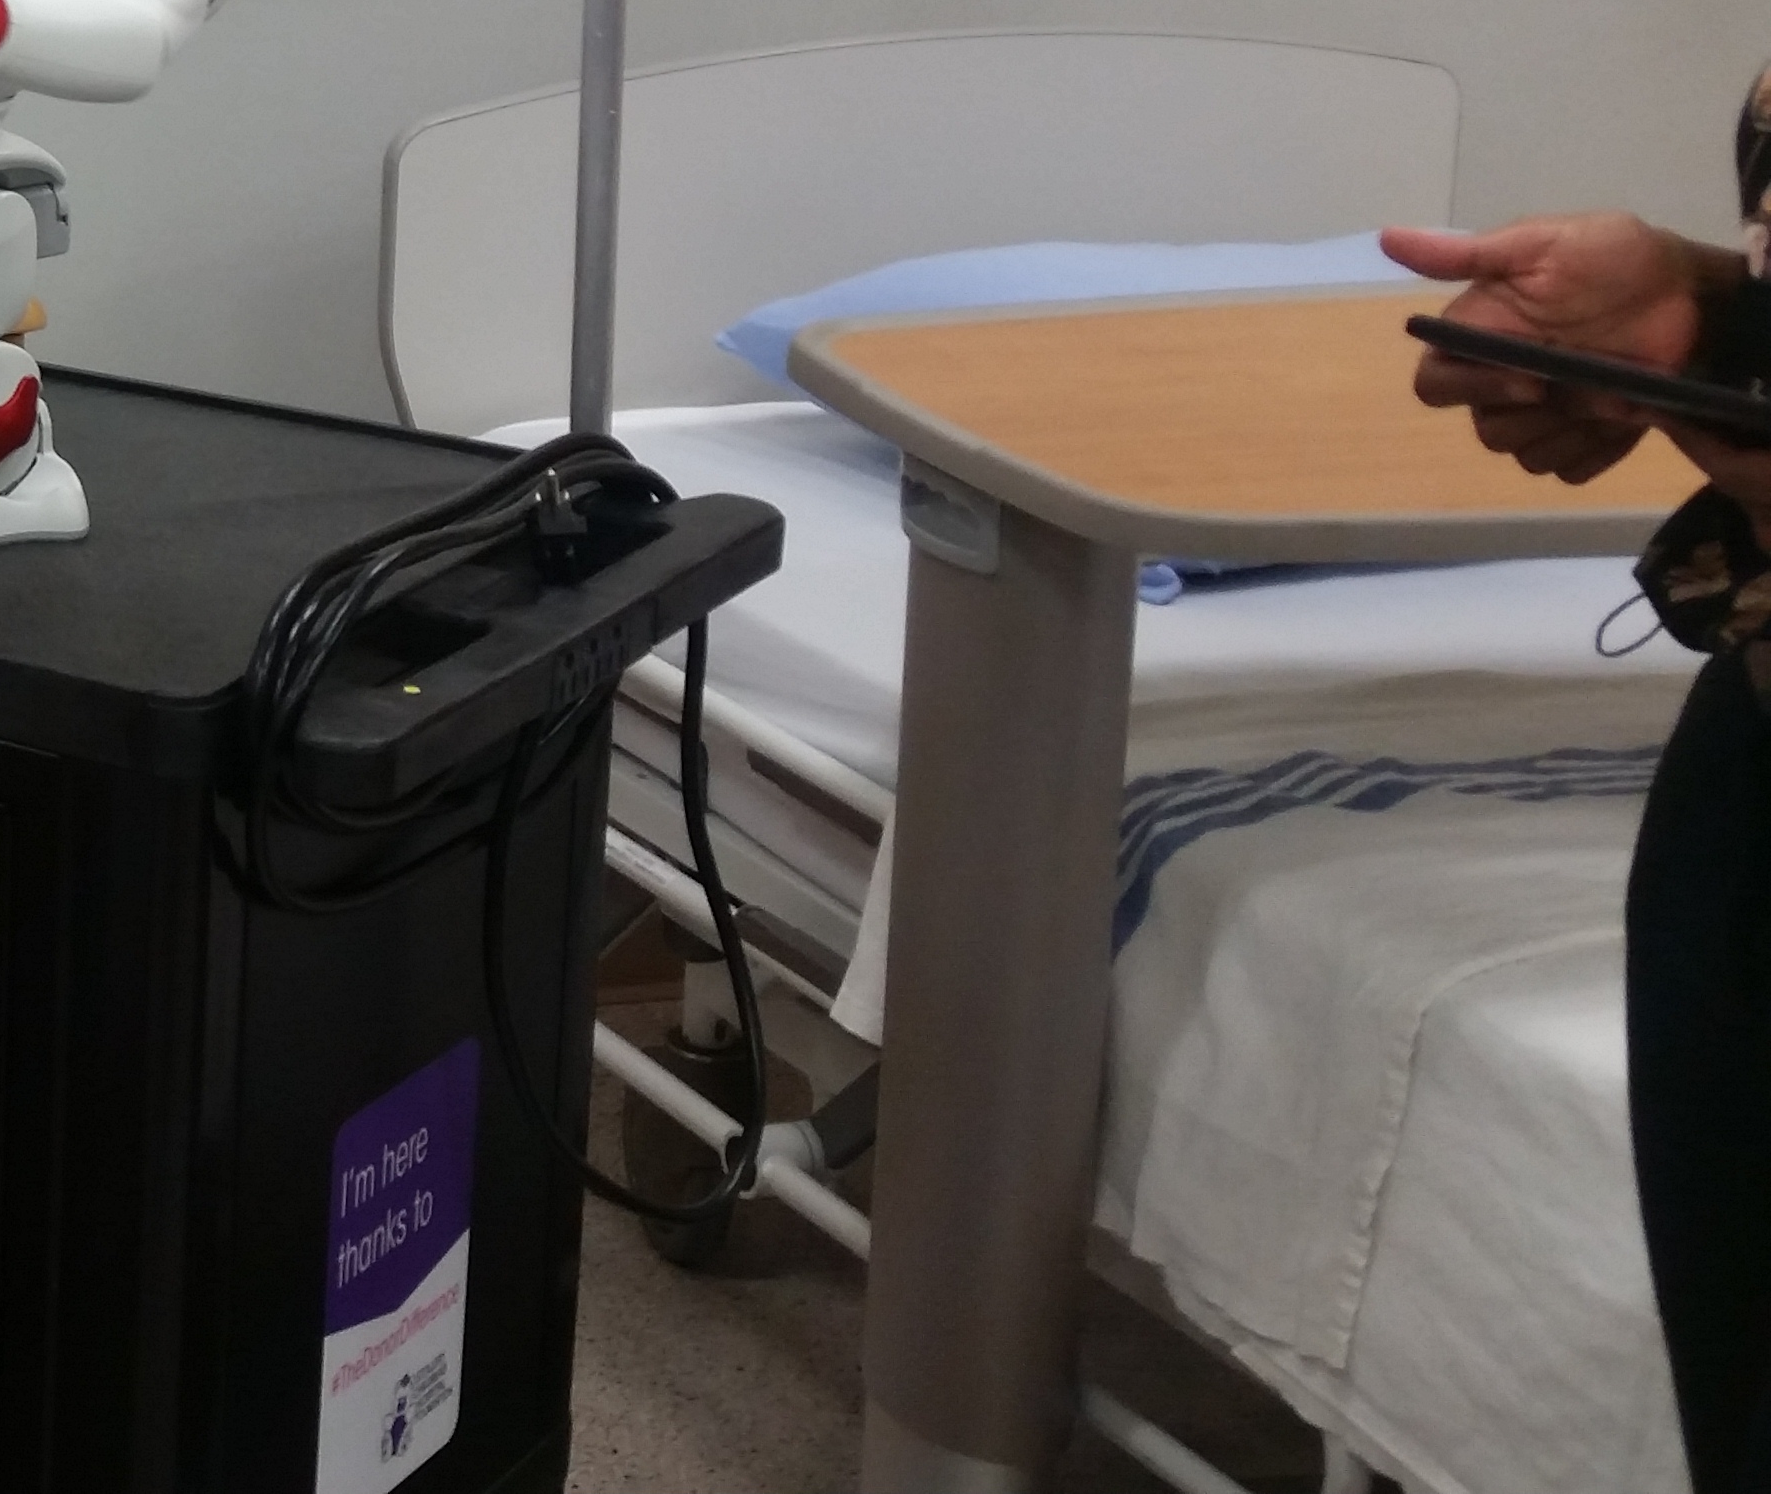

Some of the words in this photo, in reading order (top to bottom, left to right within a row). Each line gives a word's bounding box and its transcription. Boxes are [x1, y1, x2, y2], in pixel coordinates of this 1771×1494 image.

[340, 1158, 376, 1219] I'm
[382, 1126, 429, 1188] here
[335, 1207, 408, 1290] thanks
[412, 1188, 434, 1233] to
[330, 1283, 461, 1400] #TheDonorDifference
